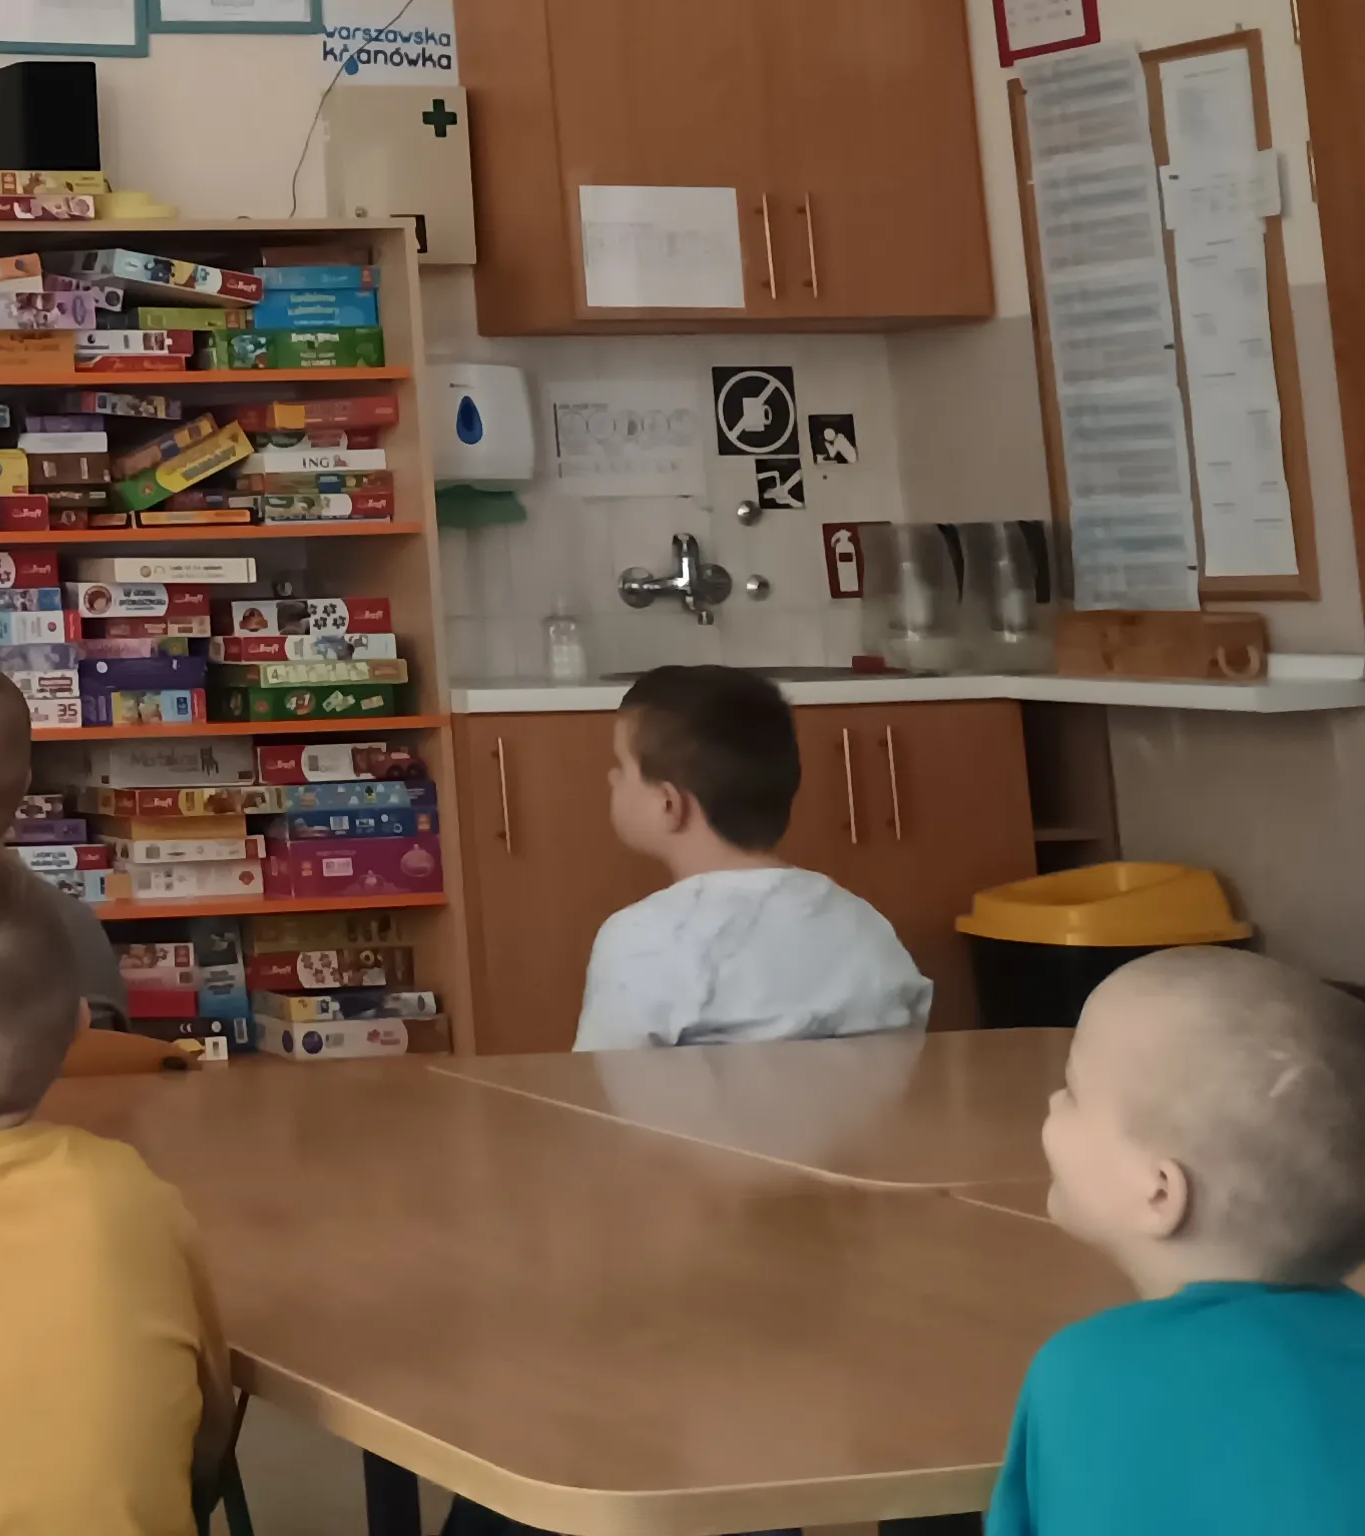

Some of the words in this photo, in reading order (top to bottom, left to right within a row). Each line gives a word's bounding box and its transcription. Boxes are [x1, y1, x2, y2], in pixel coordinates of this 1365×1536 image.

[325, 26, 451, 47] warszawska
[238, 281, 258, 294] Trefl
[302, 457, 329, 469] ING
[367, 498, 387, 509] Trefl
[365, 610, 384, 619] Trefl
[260, 644, 279, 655] Trefl
[57, 703, 78, 718] 35
